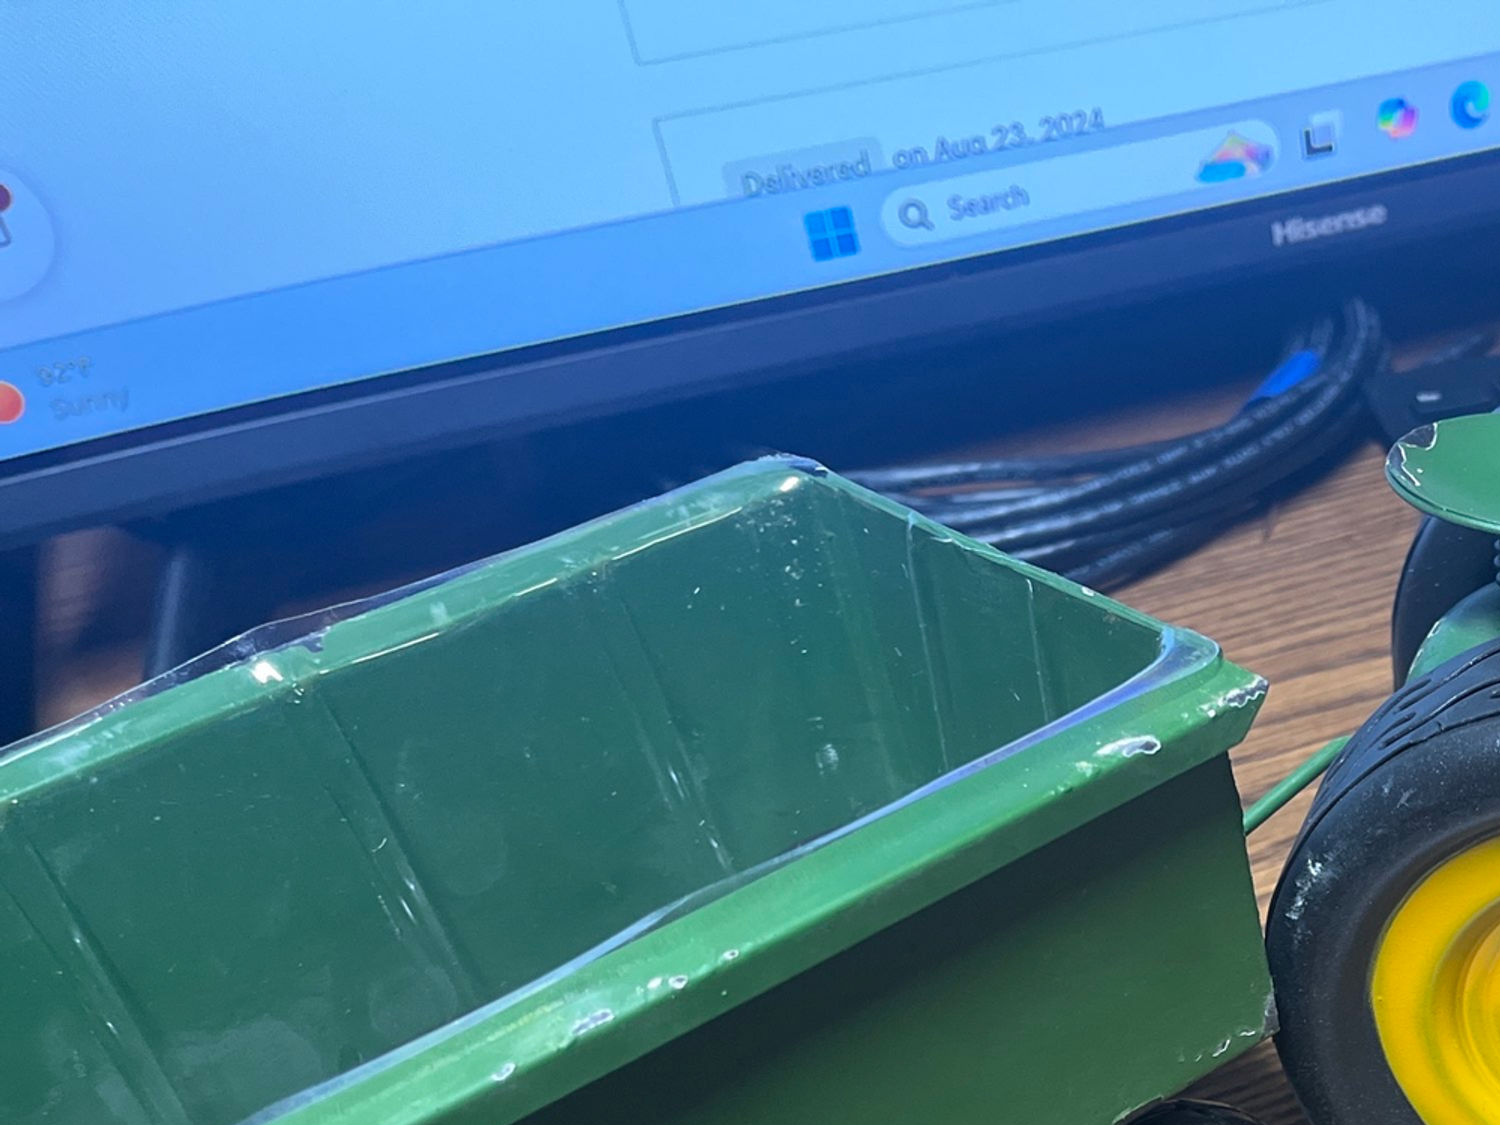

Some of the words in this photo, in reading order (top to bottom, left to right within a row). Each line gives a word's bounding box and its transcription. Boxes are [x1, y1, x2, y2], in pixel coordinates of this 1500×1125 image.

[741, 149, 871, 198] Delivered
[893, 147, 929, 170] on
[1039, 106, 1104, 141] 2024
[947, 184, 1031, 221] Search
[1271, 204, 1387, 247] Hisense
